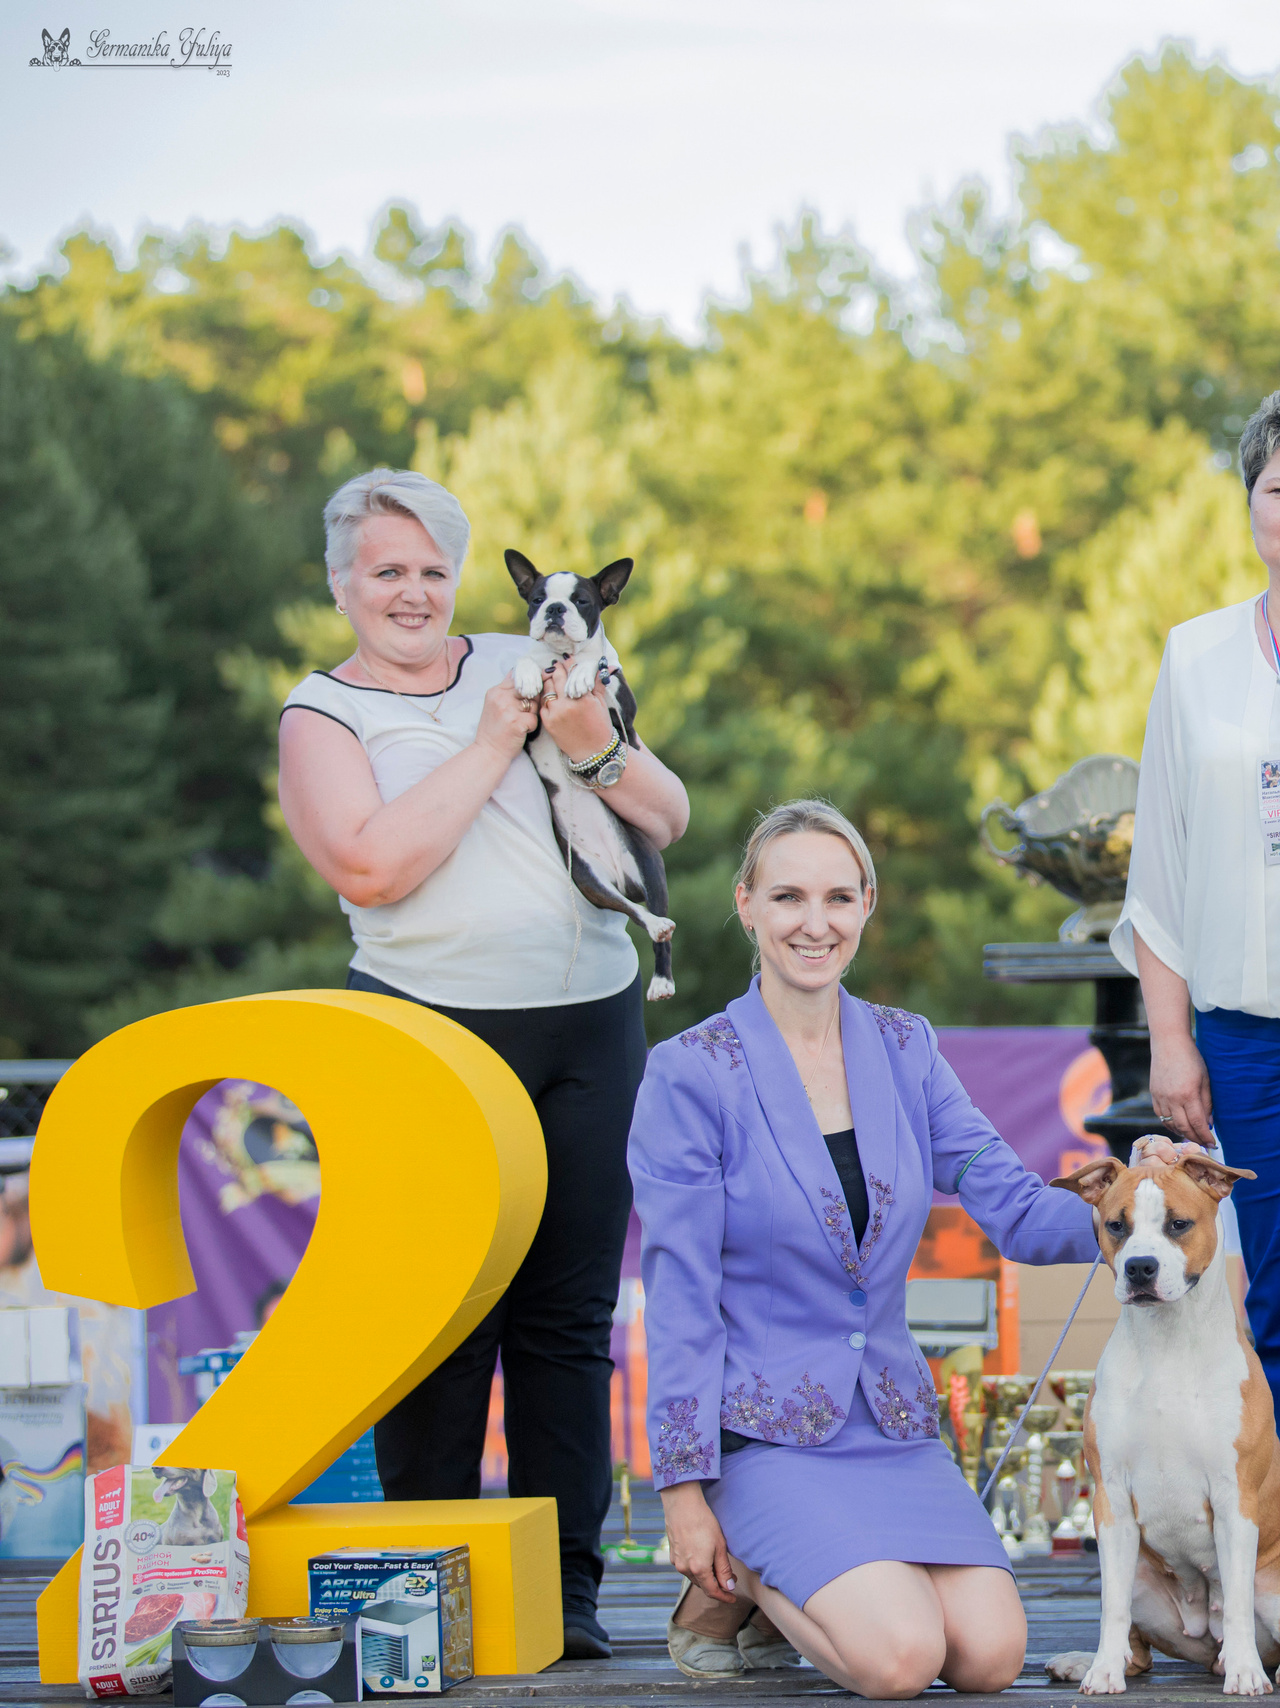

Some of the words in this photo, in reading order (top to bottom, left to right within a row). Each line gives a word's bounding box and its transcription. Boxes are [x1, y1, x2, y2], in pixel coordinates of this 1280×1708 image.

[98, 1500, 120, 1512] ADULT
[133, 1531, 155, 1542] 40%
[137, 1552, 172, 1563] МЯСНОЙ
[137, 1560, 170, 1570] РАЦИОН
[410, 1563, 433, 1571] Easy!
[319, 1578, 379, 1589] ARCTIC
[404, 1576, 431, 1588] 2X
[91, 1538, 121, 1661] SIRIUS
[319, 1590, 353, 1601] AIR
[352, 1591, 377, 1600] Ultra
[89, 1663, 117, 1671] PREMIUM
[95, 1680, 119, 1689] ADULT
